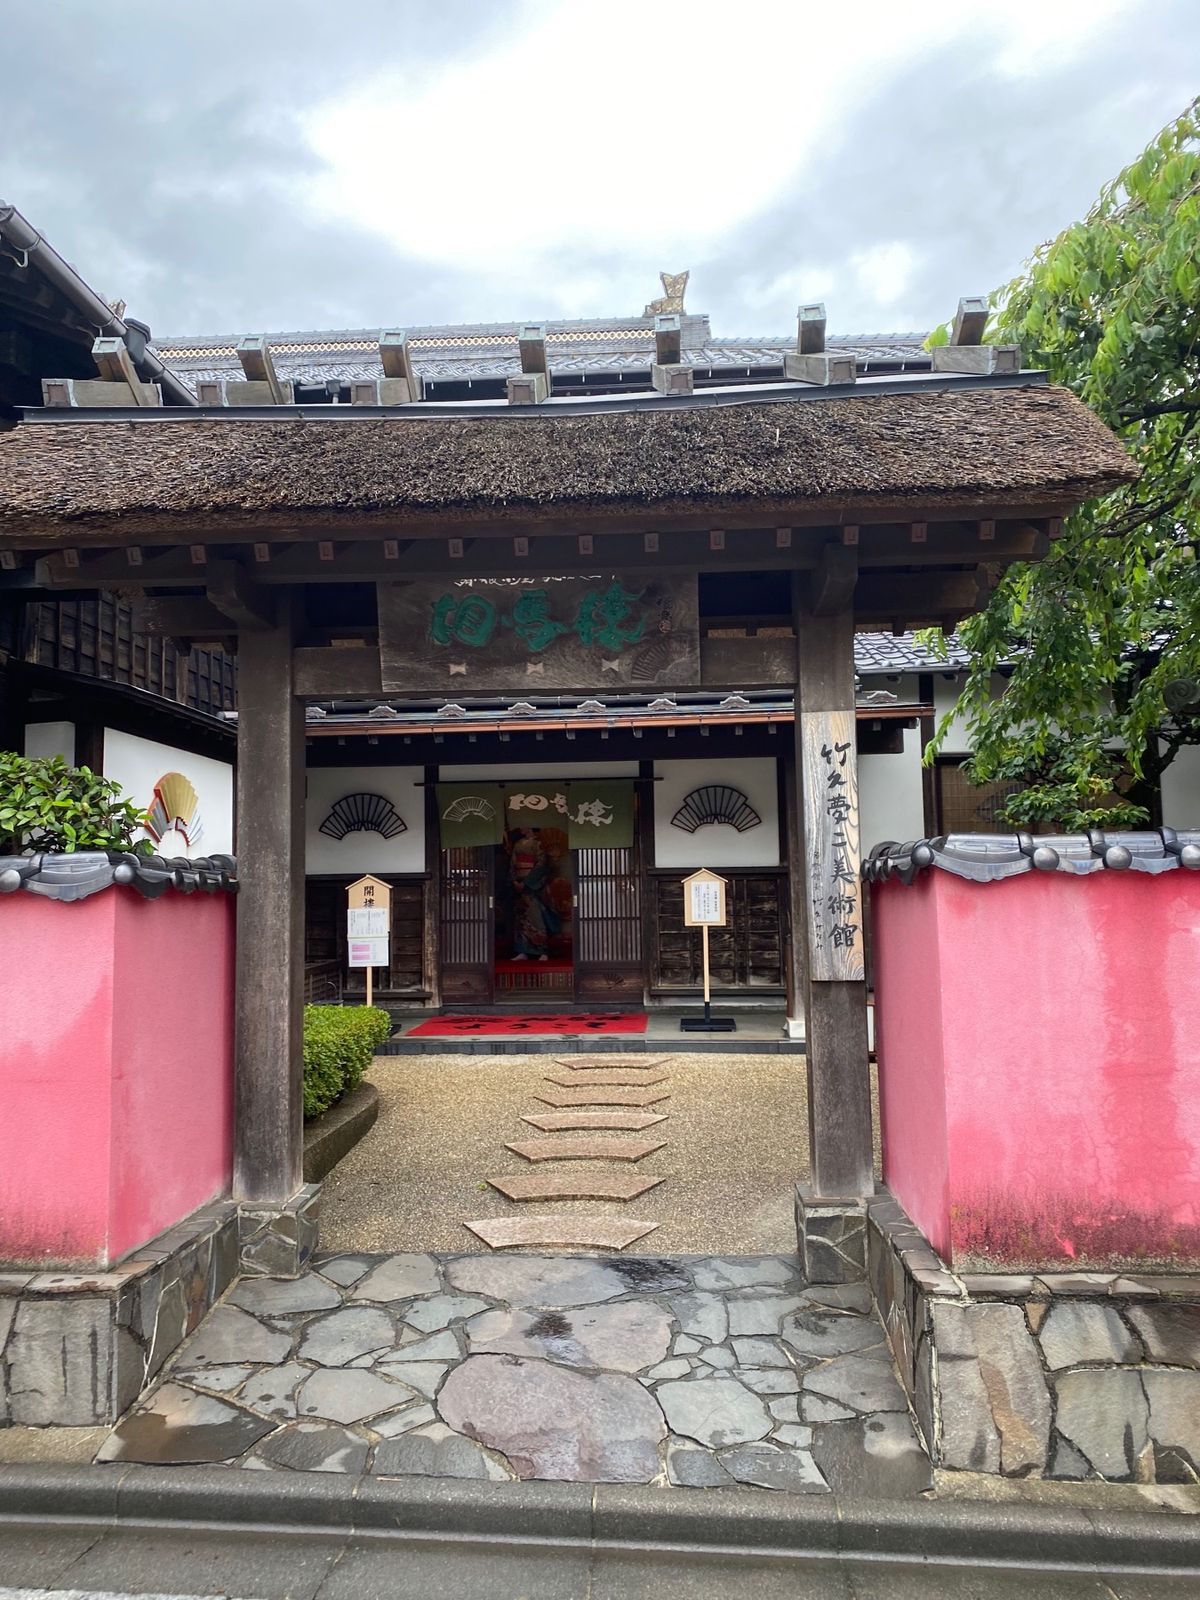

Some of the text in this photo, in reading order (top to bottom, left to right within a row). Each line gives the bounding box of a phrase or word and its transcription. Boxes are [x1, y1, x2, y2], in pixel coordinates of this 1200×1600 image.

[821, 741, 858, 949] 竹久夢二美術館
